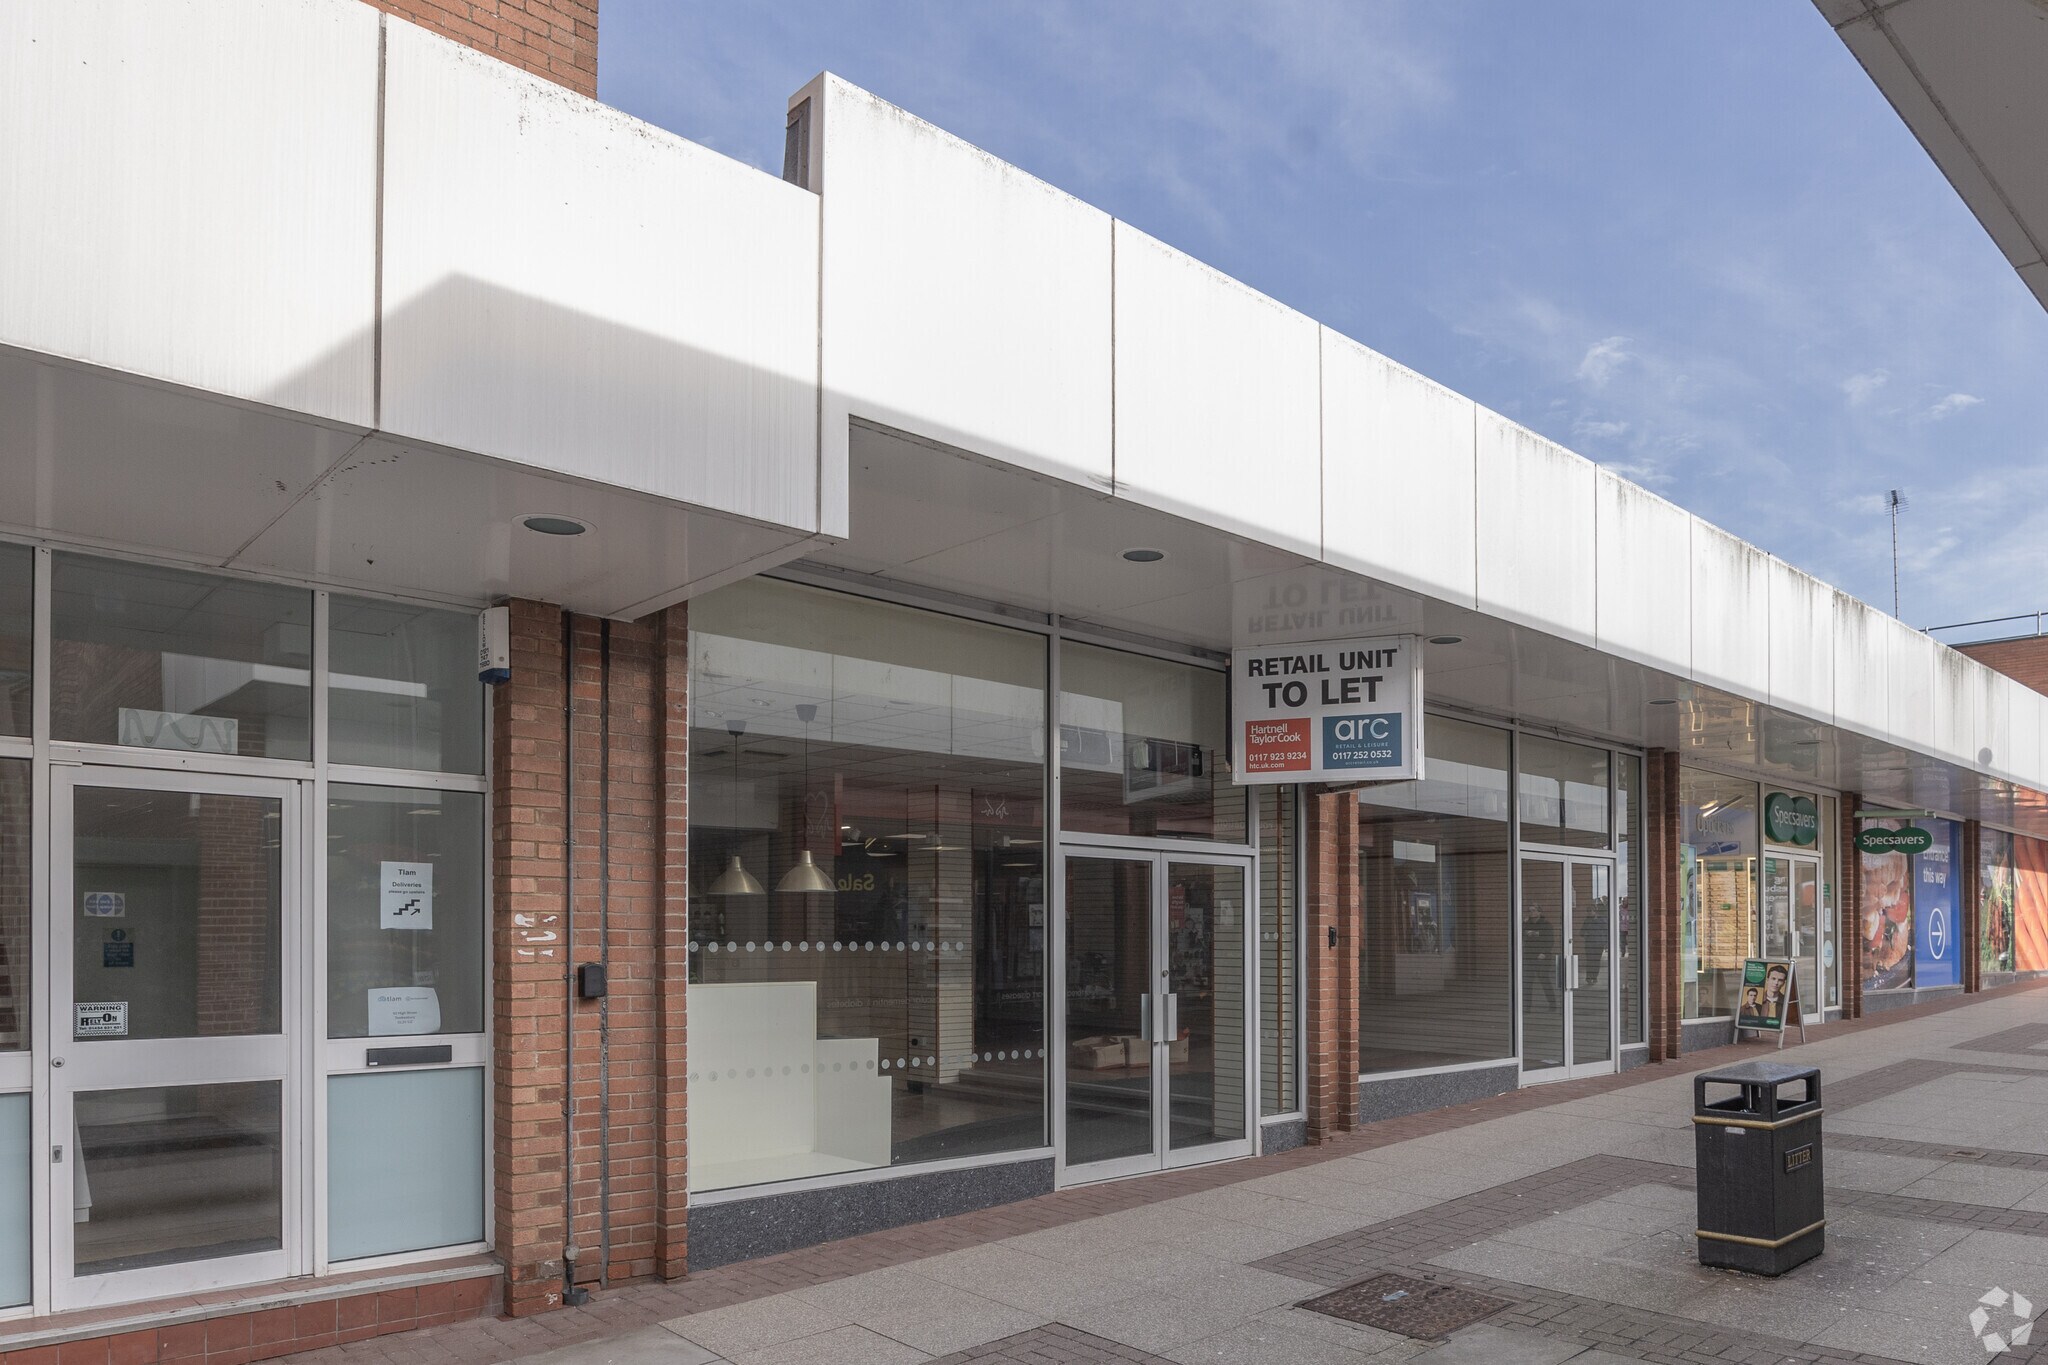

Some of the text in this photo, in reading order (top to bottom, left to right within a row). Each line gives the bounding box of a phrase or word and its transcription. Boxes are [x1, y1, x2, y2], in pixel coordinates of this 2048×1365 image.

[1249, 649, 1397, 677] RETAIL UNIT
[1262, 676, 1383, 708] TO LET
[1251, 723, 1288, 734] Hartnell
[1335, 718, 1388, 741] arc
[1333, 752, 1352, 760] 0117
[1372, 750, 1392, 758] 0532
[1774, 806, 1815, 828] Specsavers
[1863, 834, 1925, 847] Specsavers
[1923, 867, 1946, 888] this way
[1788, 1149, 1810, 1167] LITTER
